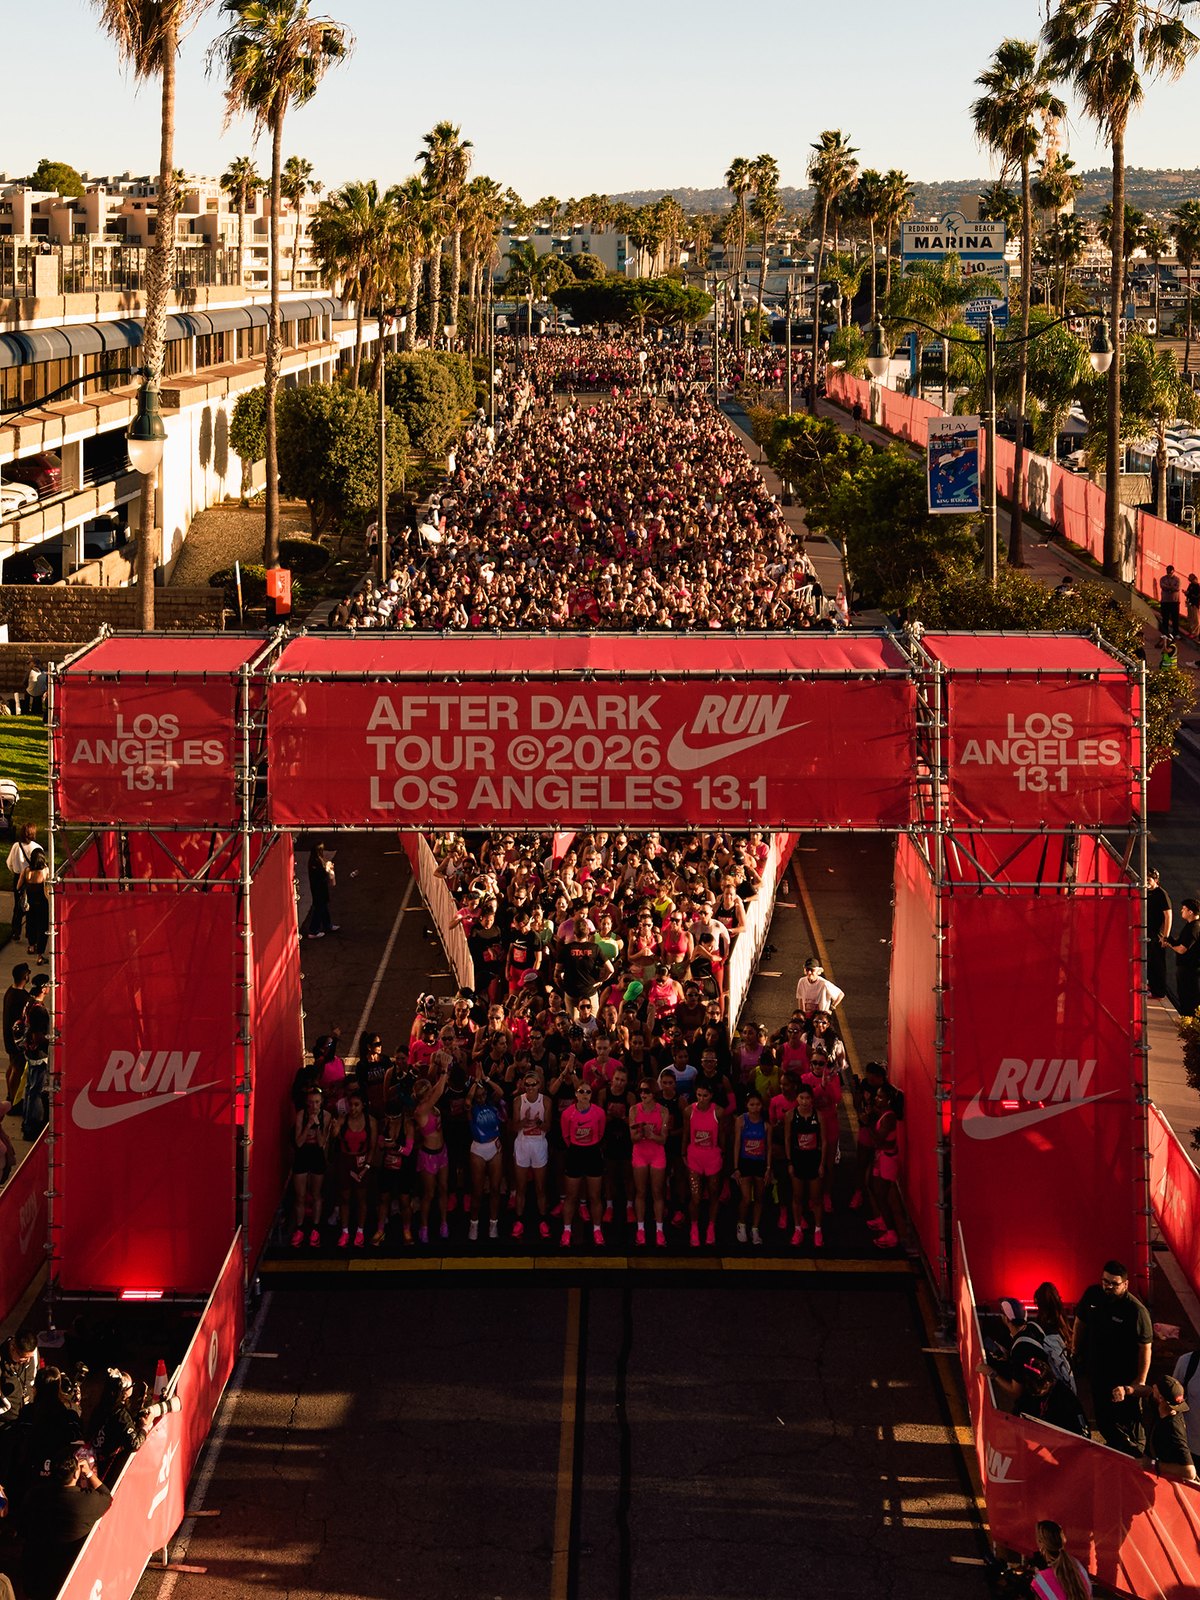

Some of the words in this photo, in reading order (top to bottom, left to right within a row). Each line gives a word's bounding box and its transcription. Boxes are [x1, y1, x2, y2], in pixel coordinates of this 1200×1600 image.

[908, 225, 939, 233] REDONDO
[914, 236, 993, 249] MARINA
[970, 299, 992, 307] WATER
[941, 423, 968, 431] PLAY
[366, 695, 519, 730] AFTER
[531, 695, 662, 730] DARK
[690, 694, 790, 735] RUN
[1007, 712, 1074, 739] LOS
[116, 713, 180, 739] LOS
[71, 739, 225, 765] ANGELES
[366, 735, 495, 771] TOUR
[960, 739, 1122, 766] ANGELES
[121, 765, 174, 791] 13.1
[1013, 766, 1068, 792] 13.1
[370, 775, 458, 810] LOS
[467, 775, 683, 810] ANGELES
[693, 775, 767, 810] 13.1
[96, 1050, 202, 1093] RUN
[987, 1057, 1098, 1102] RUN
